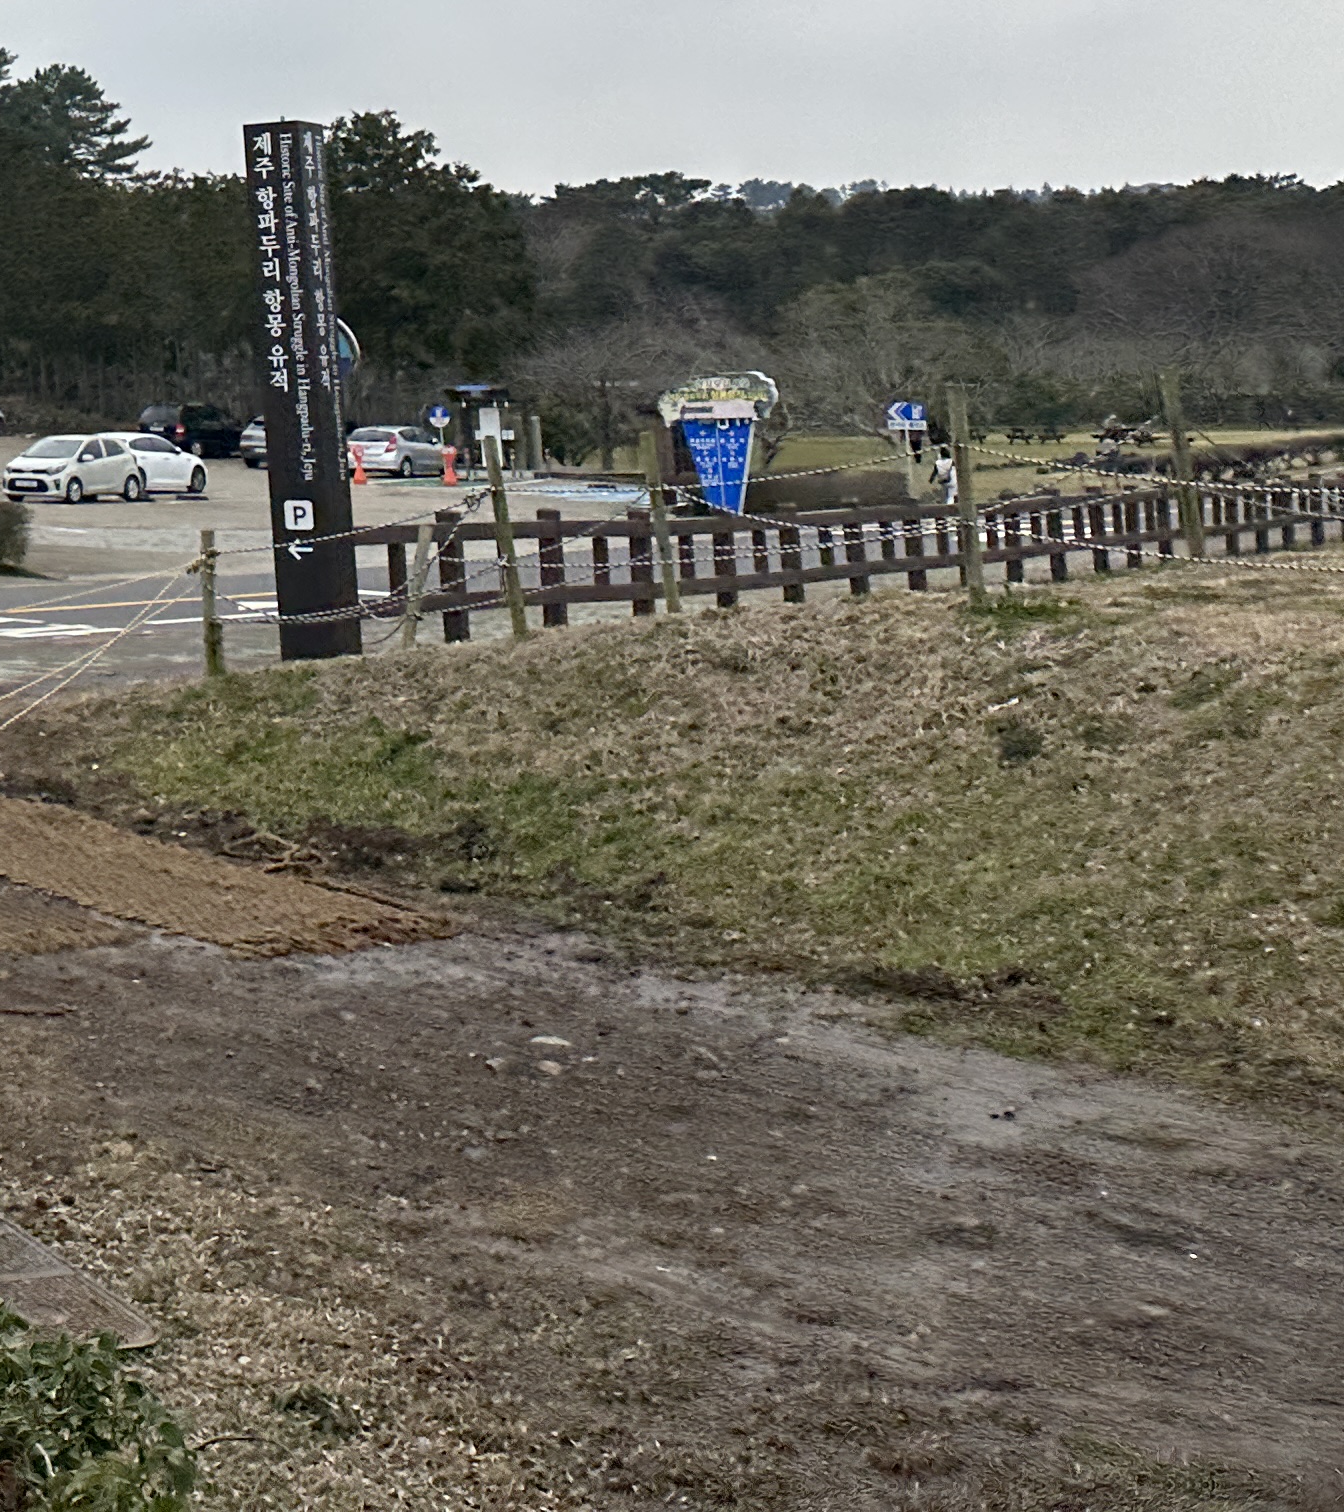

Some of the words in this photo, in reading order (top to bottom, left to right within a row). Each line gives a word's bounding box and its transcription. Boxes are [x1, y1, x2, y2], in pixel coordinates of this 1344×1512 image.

[252, 131, 275, 180] 제주
[279, 133, 293, 179] Historic
[303, 131, 316, 179] 제주
[282, 181, 296, 204] Site
[284, 206, 298, 219] of
[254, 186, 281, 282] 항파두리
[306, 185, 324, 282] 항파두리
[286, 219, 303, 311] Anti-Mongolian
[262, 288, 287, 337] 항몽
[314, 287, 327, 337] 항몽
[290, 313, 309, 361] Struggle
[267, 344, 289, 393] 유적
[296, 363, 309, 376] in
[318, 343, 331, 393] 유적
[293, 506, 307, 526] P
